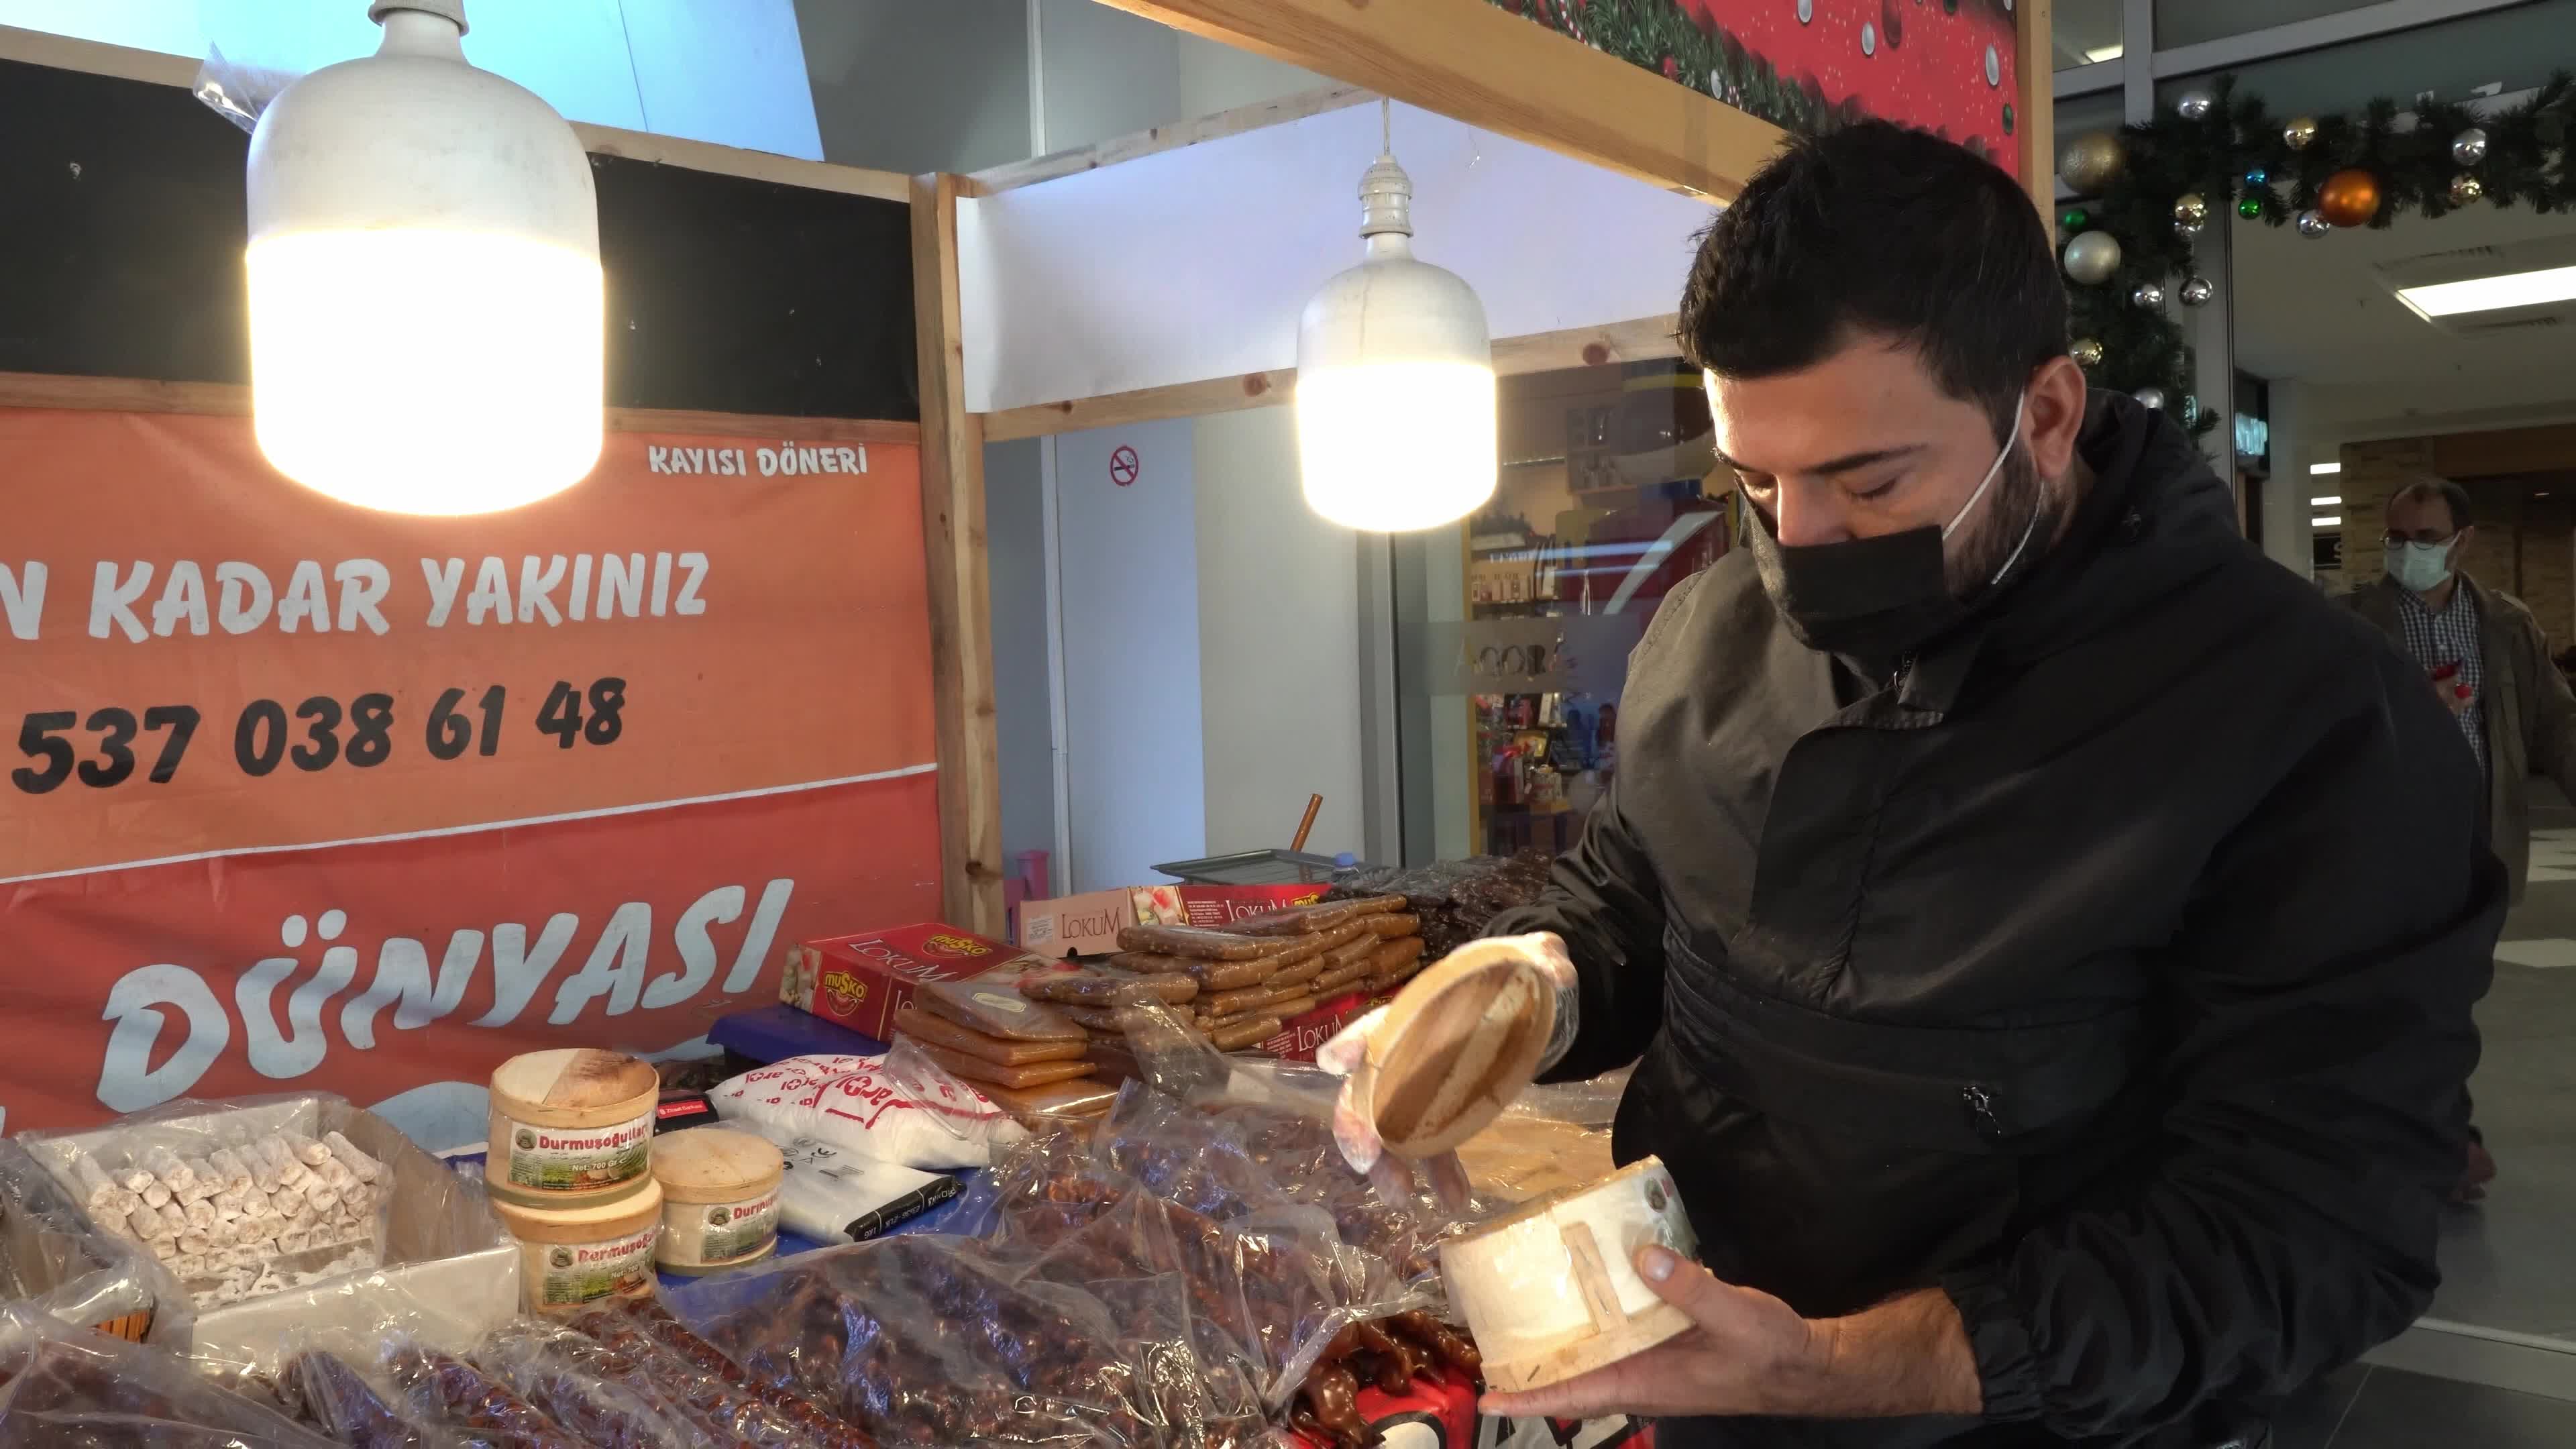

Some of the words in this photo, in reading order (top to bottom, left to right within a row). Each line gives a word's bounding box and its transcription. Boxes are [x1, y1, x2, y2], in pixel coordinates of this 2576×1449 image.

[648, 445, 747, 476] KAYISI
[756, 441, 867, 477] DÖNERİ
[89, 557, 390, 643] KADAR
[421, 552, 709, 627] YAKINIZ
[11, 705, 201, 794] 537
[235, 693, 394, 777] 038
[426, 685, 506, 760] 61
[537, 677, 627, 749] 48
[1062, 906, 1120, 939] LOKUM
[849, 938, 959, 982] LOKUM
[97, 879, 794, 1113] DÜNYASI
